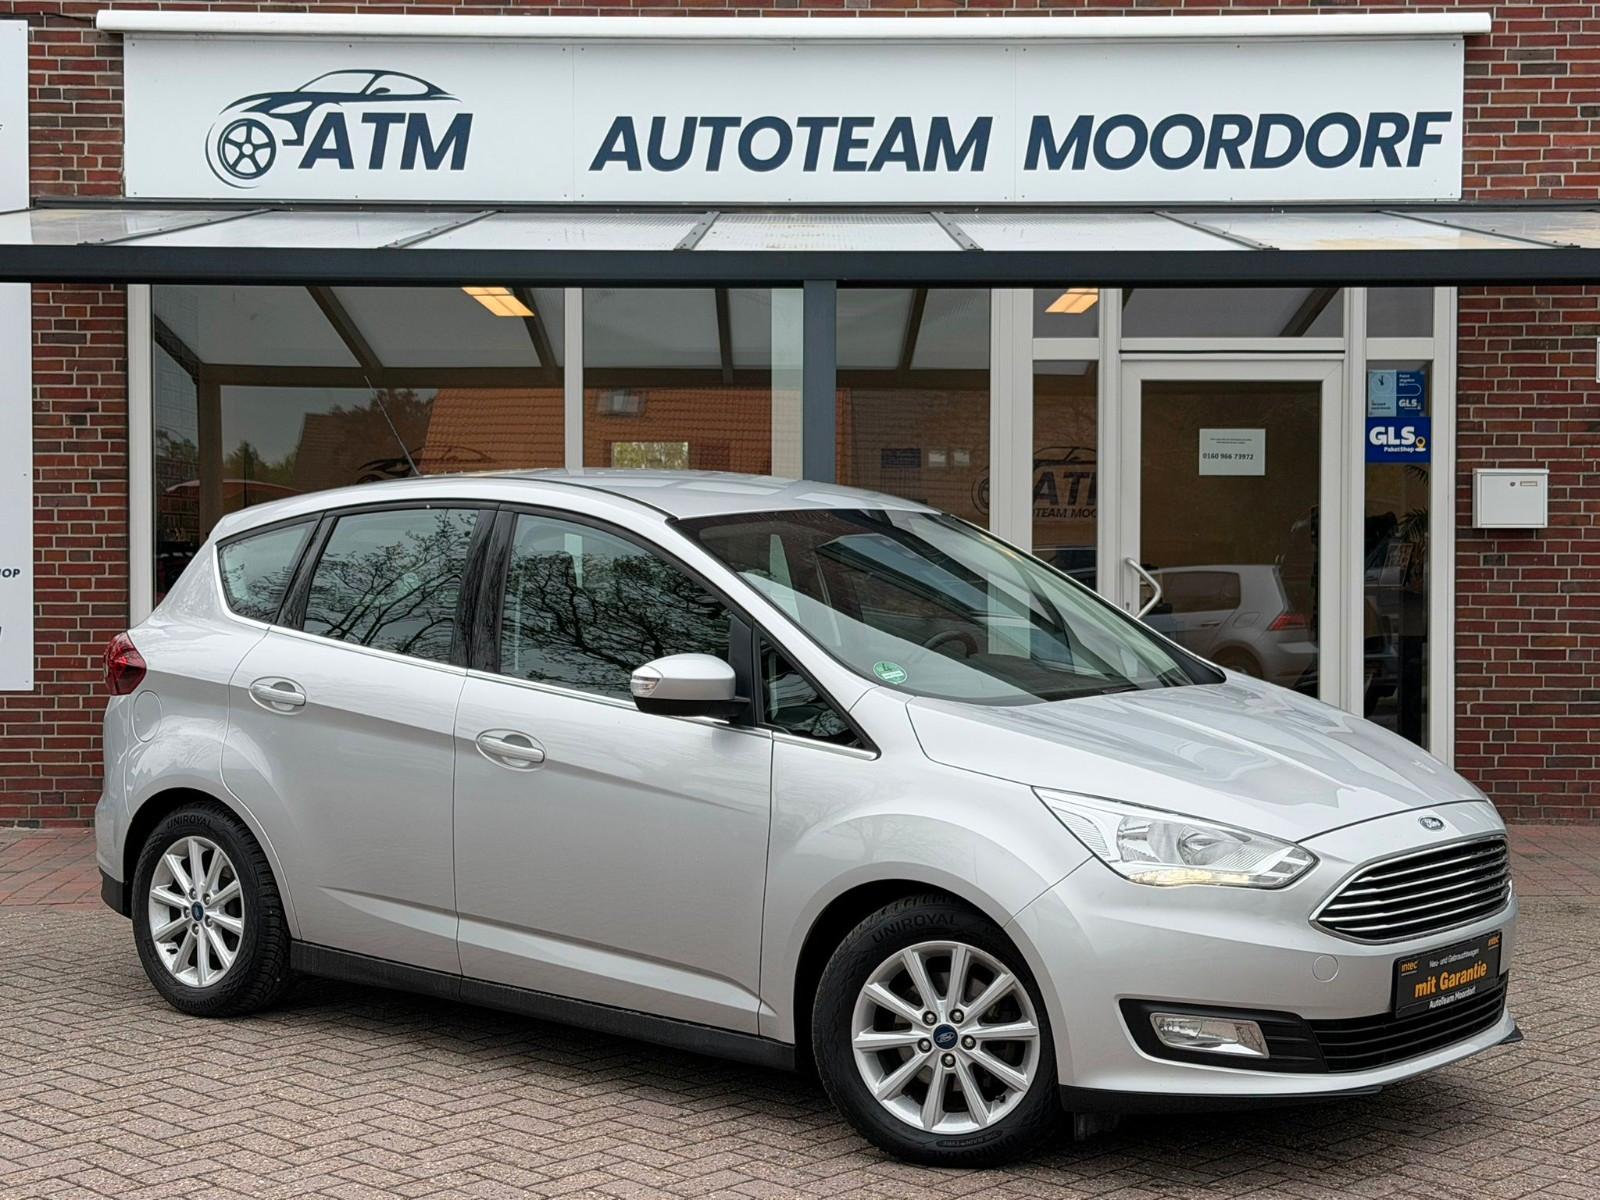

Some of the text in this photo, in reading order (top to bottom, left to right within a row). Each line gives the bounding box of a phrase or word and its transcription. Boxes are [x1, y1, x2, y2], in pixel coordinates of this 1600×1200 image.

[299, 112, 474, 171] ATM
[589, 112, 1453, 172] AUTOTEAM MOORDORF
[1398, 399, 1418, 407] GLS
[1369, 426, 1416, 445] GLS
[1033, 471, 1096, 506] AT
[1034, 507, 1067, 518] TEAM
[0, 568, 21, 578] OP
[871, 912, 961, 944] UNIROYAL
[1414, 961, 1487, 997] mit Garantie
